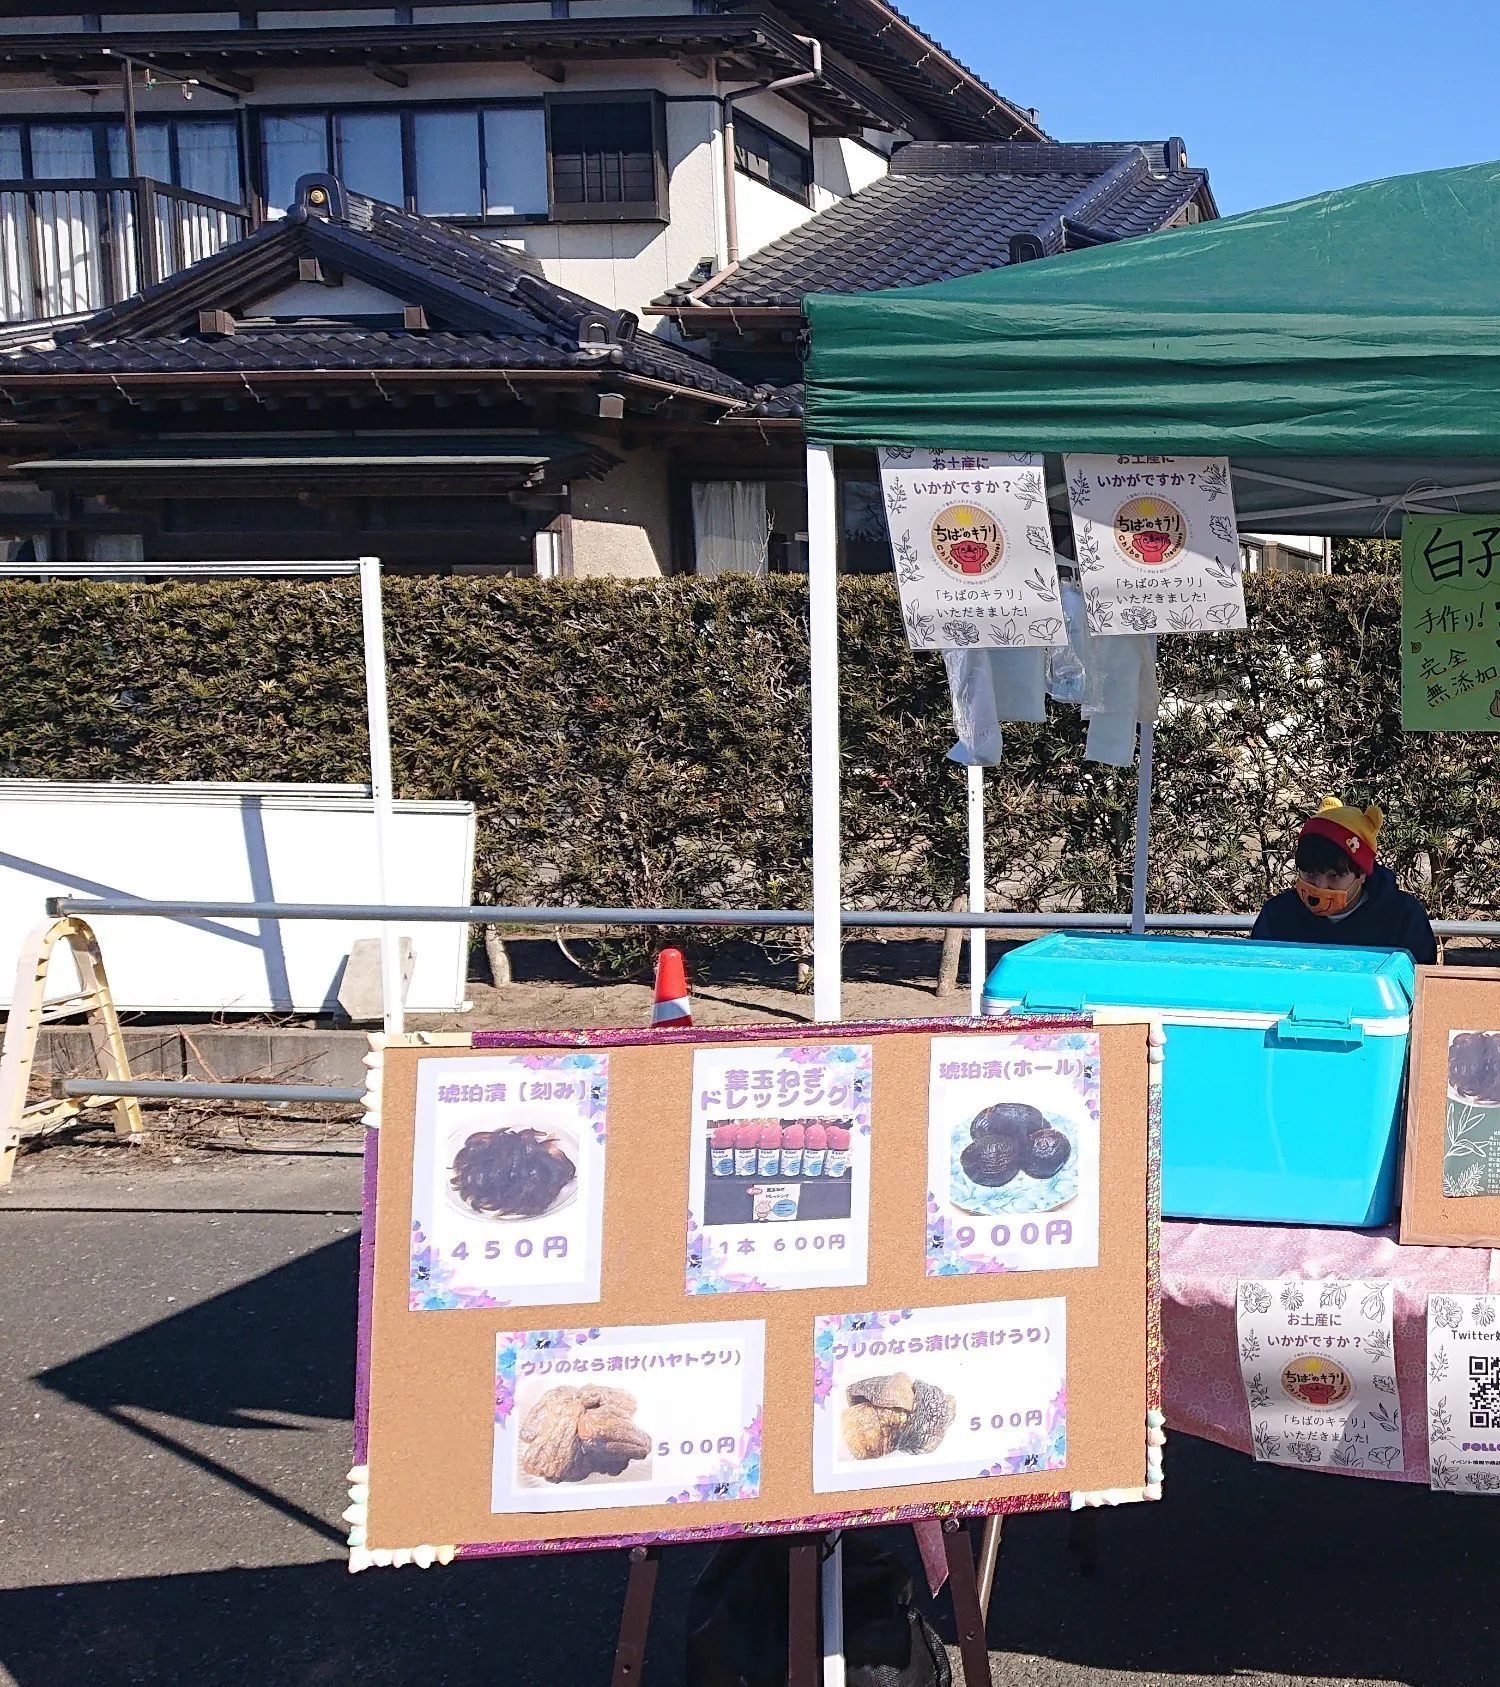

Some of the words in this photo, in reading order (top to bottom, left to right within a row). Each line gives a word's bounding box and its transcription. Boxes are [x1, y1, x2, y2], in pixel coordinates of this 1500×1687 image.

[932, 457, 990, 471] お土産に
[913, 480, 1012, 495] いかがですか？
[1097, 473, 1196, 488] いかがですか？
[1117, 514, 1180, 533] ちばのキラリ
[934, 524, 997, 542] ちばのキラリ
[1115, 576, 1203, 590] 「ちばのキラリ」
[936, 588, 1024, 602] 「ちばのキラリ」
[1116, 592, 1207, 604] いただきました!
[936, 606, 1028, 618] いただきました!
[1419, 647, 1470, 680] 完全
[1425, 665, 1499, 708] 無添加
[939, 1059, 1084, 1081] 琥珀漬(ホール)
[724, 1066, 827, 1092] 葉玉ねぎ
[701, 1084, 852, 1110] ドレッシング
[956, 1220, 1073, 1248] 900円
[451, 1236, 568, 1260] 450円
[1287, 1313, 1341, 1326] お土産に
[1267, 1335, 1361, 1348] いかがですか？
[1284, 1370, 1344, 1385] ちばのキラリ
[969, 1411, 1044, 1431] 500円
[1284, 1414, 1366, 1429] 「ちばのキラリ」
[1284, 1430, 1369, 1443] いただきました!
[658, 1437, 735, 1457] 500円
